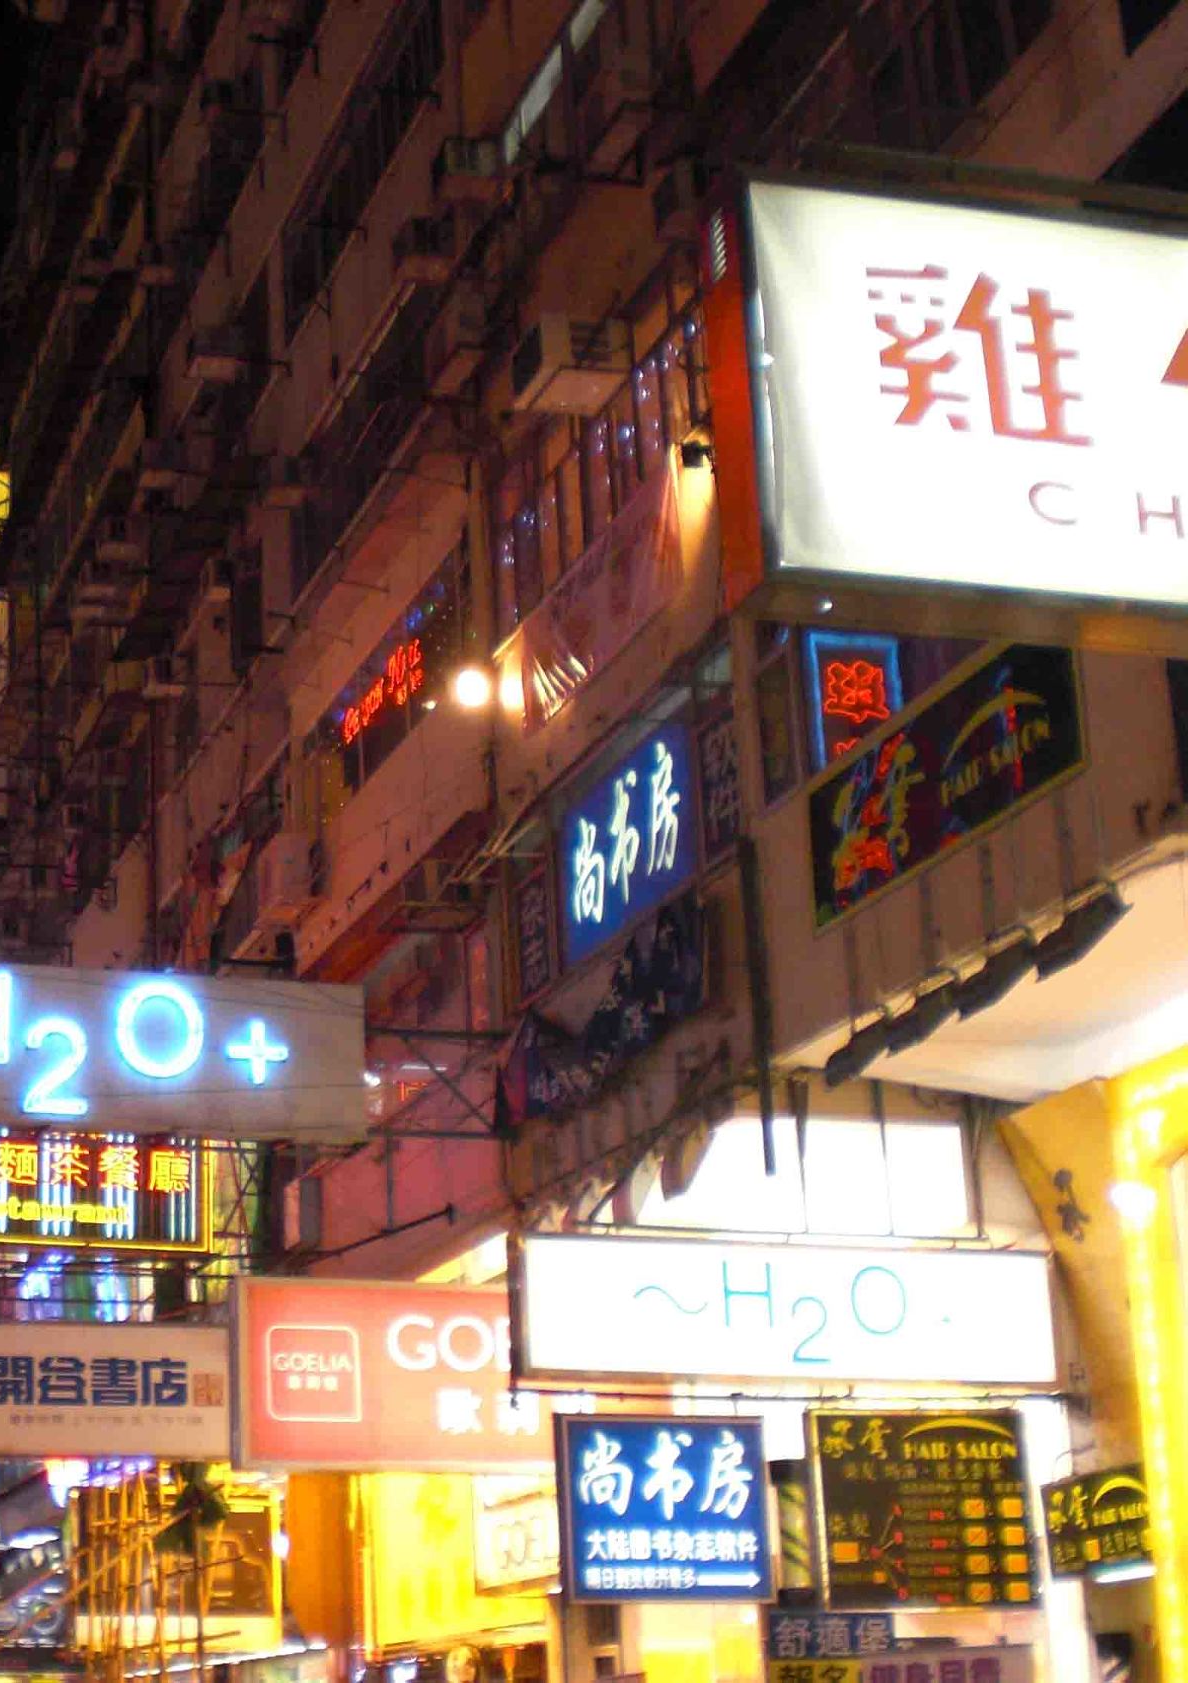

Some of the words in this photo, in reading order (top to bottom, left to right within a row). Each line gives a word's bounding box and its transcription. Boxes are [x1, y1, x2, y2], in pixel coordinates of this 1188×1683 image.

[272, 1351, 354, 1372] GOELIA
[578, 1429, 755, 1520] 尚书房
